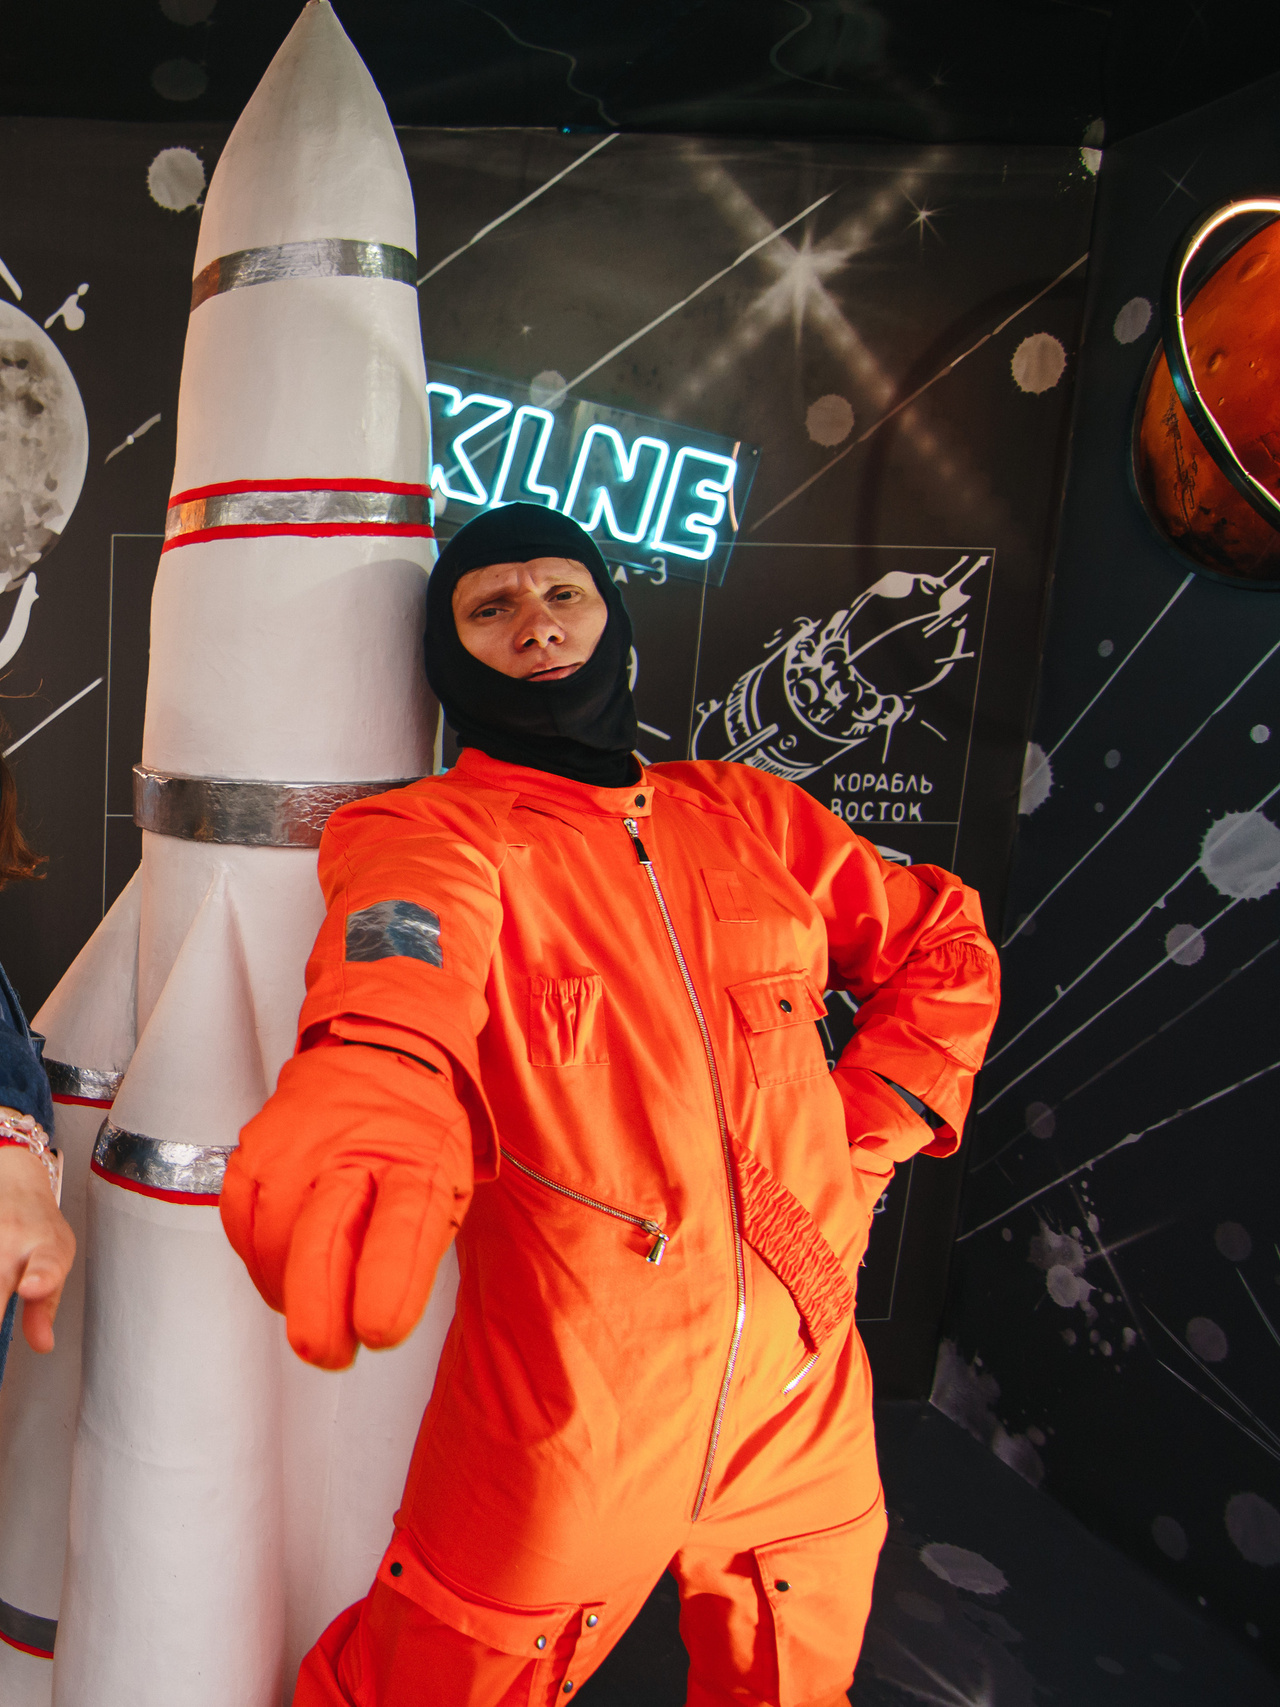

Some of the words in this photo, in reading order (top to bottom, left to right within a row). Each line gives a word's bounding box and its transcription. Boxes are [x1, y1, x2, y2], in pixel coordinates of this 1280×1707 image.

[607, 556, 667, 586] А-3
[833, 772, 933, 794] КОРАБЛЬ
[831, 798, 922, 822] ВОСТОК
